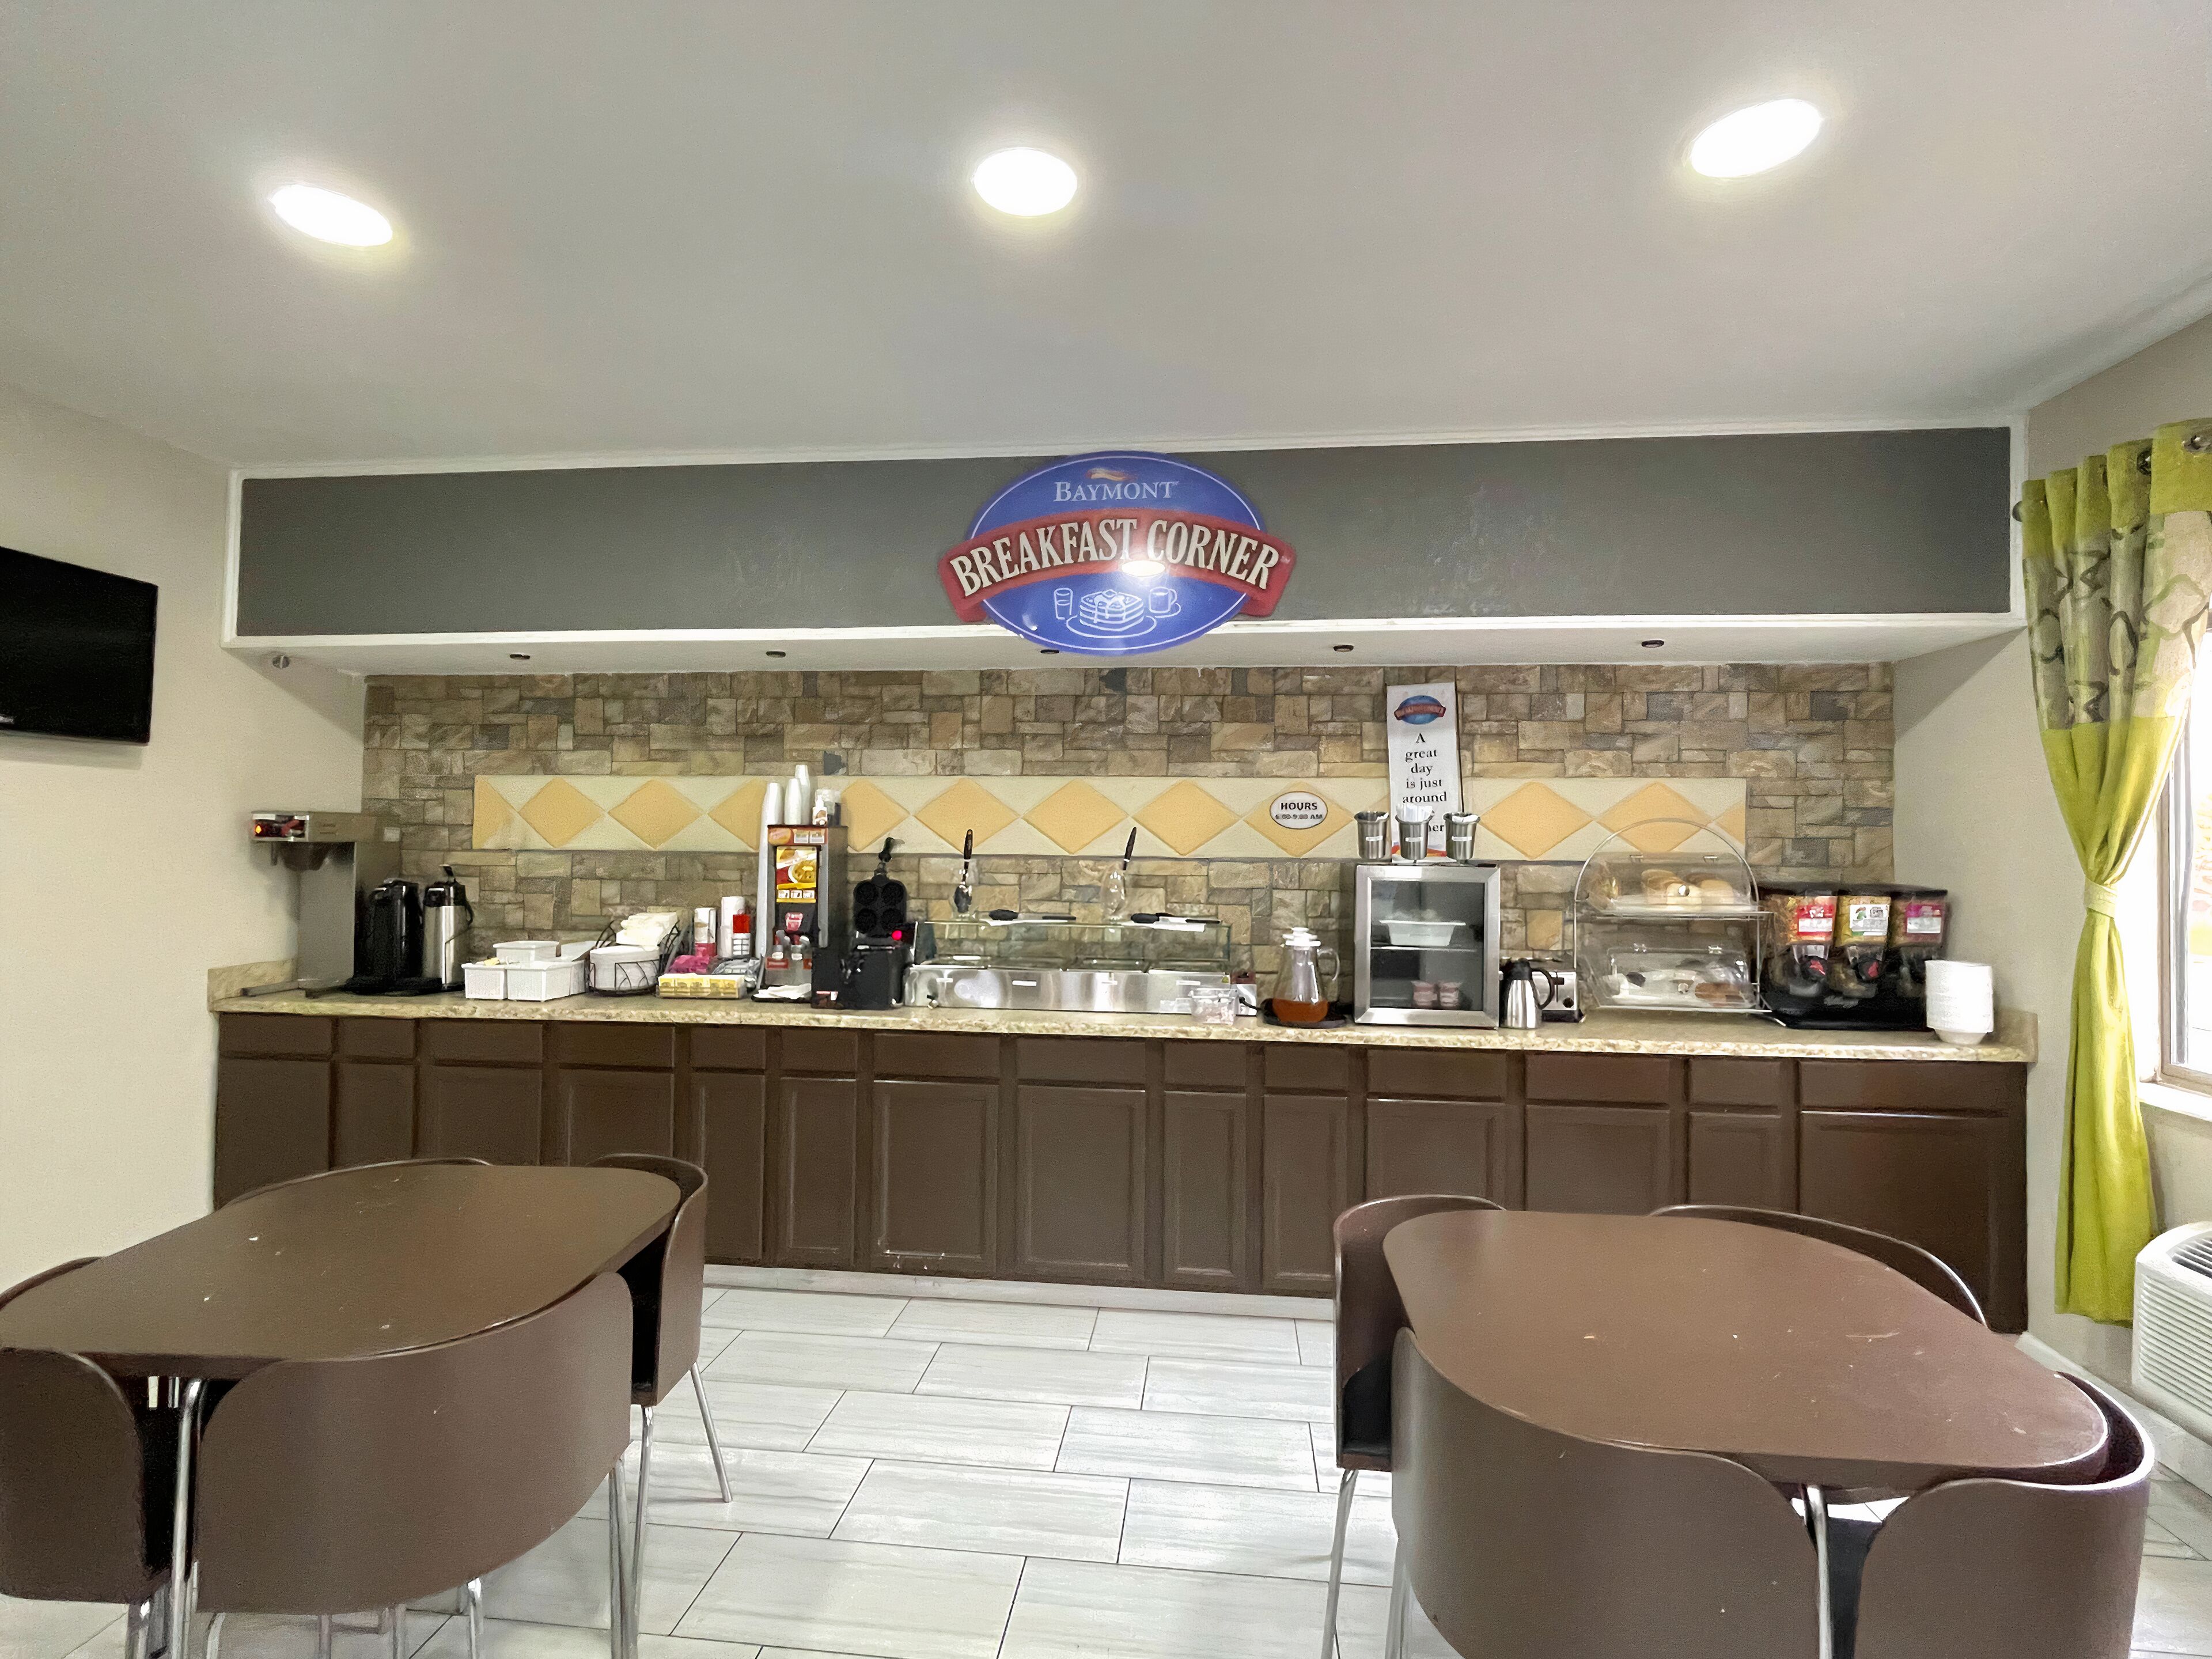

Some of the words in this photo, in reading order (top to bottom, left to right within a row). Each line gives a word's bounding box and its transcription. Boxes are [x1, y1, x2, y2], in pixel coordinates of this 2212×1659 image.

[1053, 480, 1179, 502] BAYMONT
[950, 518, 1137, 597] BREAKFAST
[1147, 519, 1279, 590] CORNER
[1415, 733, 1426, 743] A
[1405, 749, 1437, 763] great
[1411, 763, 1433, 776] day
[1406, 778, 1415, 789] is
[1420, 778, 1442, 791] just
[1403, 791, 1447, 803] around
[1281, 802, 1317, 811] HOURS
